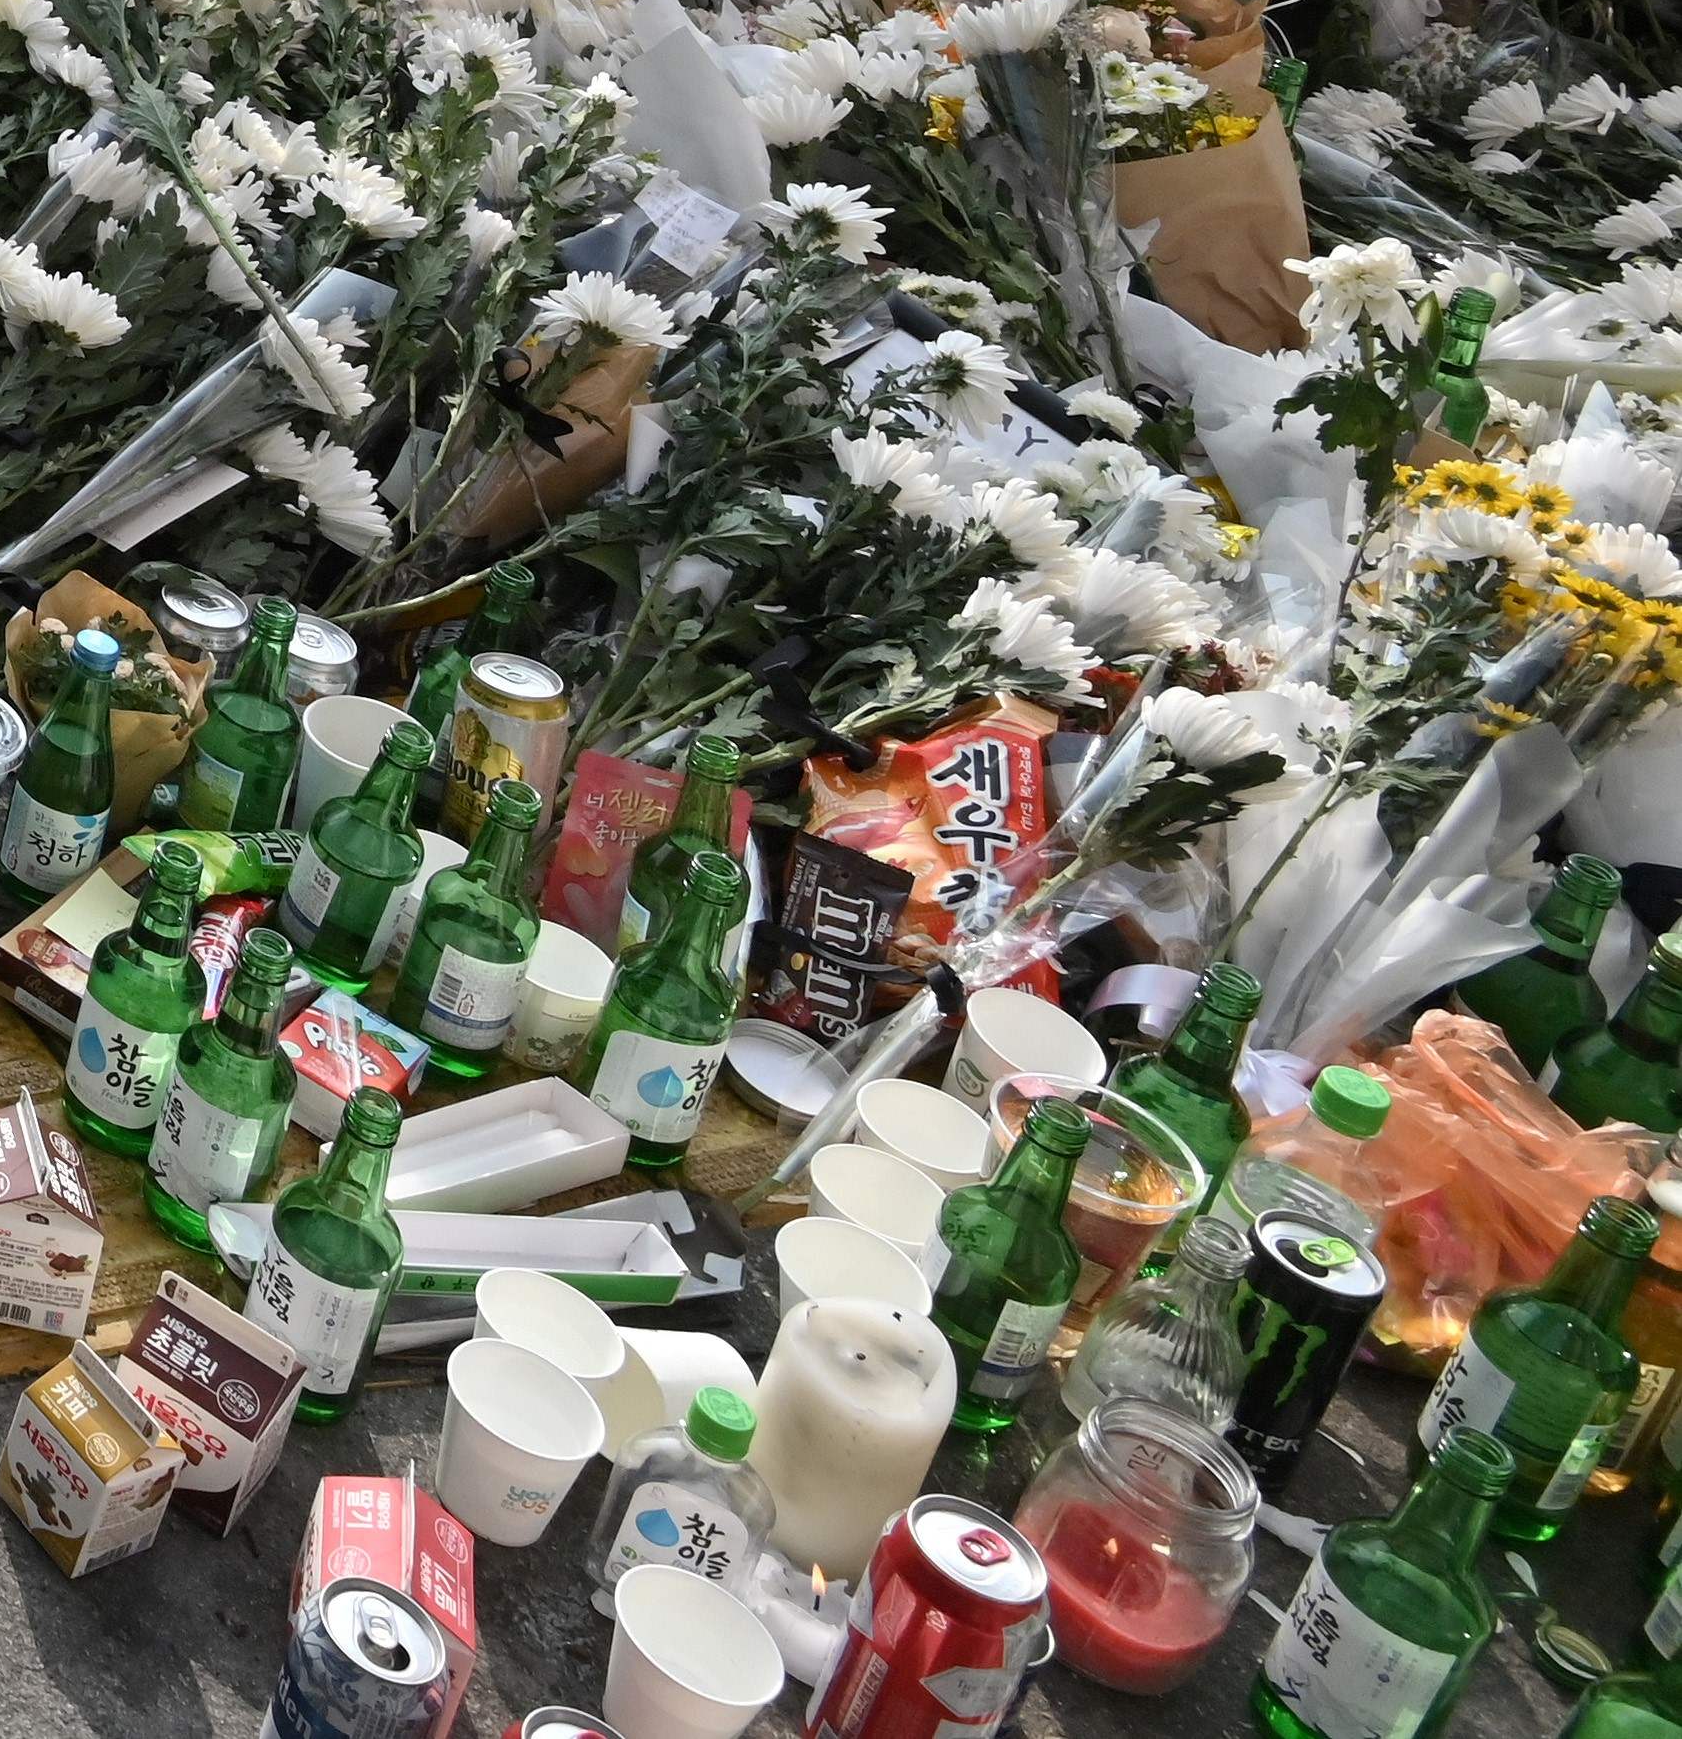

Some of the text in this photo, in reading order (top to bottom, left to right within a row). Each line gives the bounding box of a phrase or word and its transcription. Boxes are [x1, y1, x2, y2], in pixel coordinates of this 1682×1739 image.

[27, 831, 87, 866] 청하
[106, 1033, 155, 1108] 참이슬
[145, 1327, 220, 1383] 초콜릿
[161, 1314, 208, 1347] 서울우유
[50, 1382, 88, 1421] 커피
[134, 1385, 228, 1460] 서울우유
[21, 1418, 89, 1498] 서울우유
[347, 1489, 374, 1529] 딸기
[377, 1492, 390, 1530] 서울우유
[678, 1513, 730, 1579] 참이슬
[435, 1561, 457, 1616] 딸기
